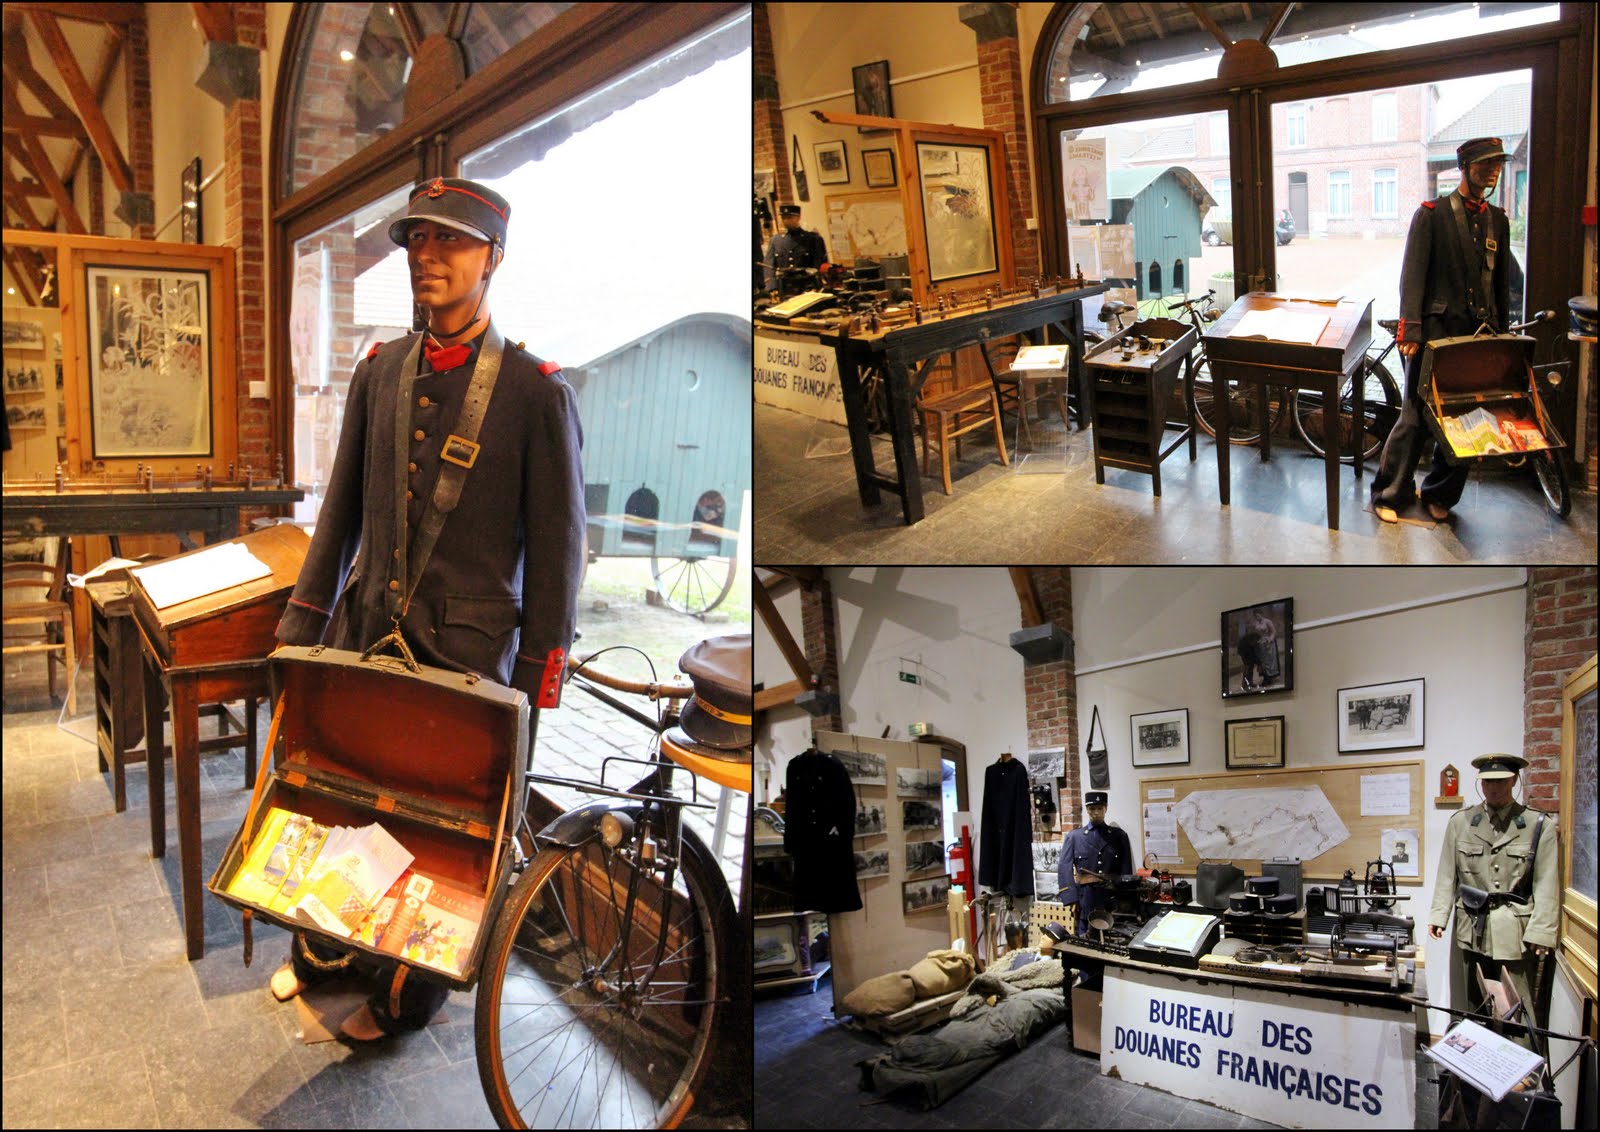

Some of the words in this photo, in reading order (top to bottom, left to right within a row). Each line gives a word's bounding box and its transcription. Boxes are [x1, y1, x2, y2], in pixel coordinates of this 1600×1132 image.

[767, 347, 799, 367] BUREAU
[809, 354, 827, 373] DES
[754, 367, 788, 389] DOUANES
[793, 375, 842, 402] FRANÇAISE
[1149, 999, 1234, 1038] BUREAU
[1261, 1019, 1313, 1055] DES
[1114, 1026, 1201, 1069] DOUANES
[1216, 1049, 1383, 1116] FRANÇAISES
